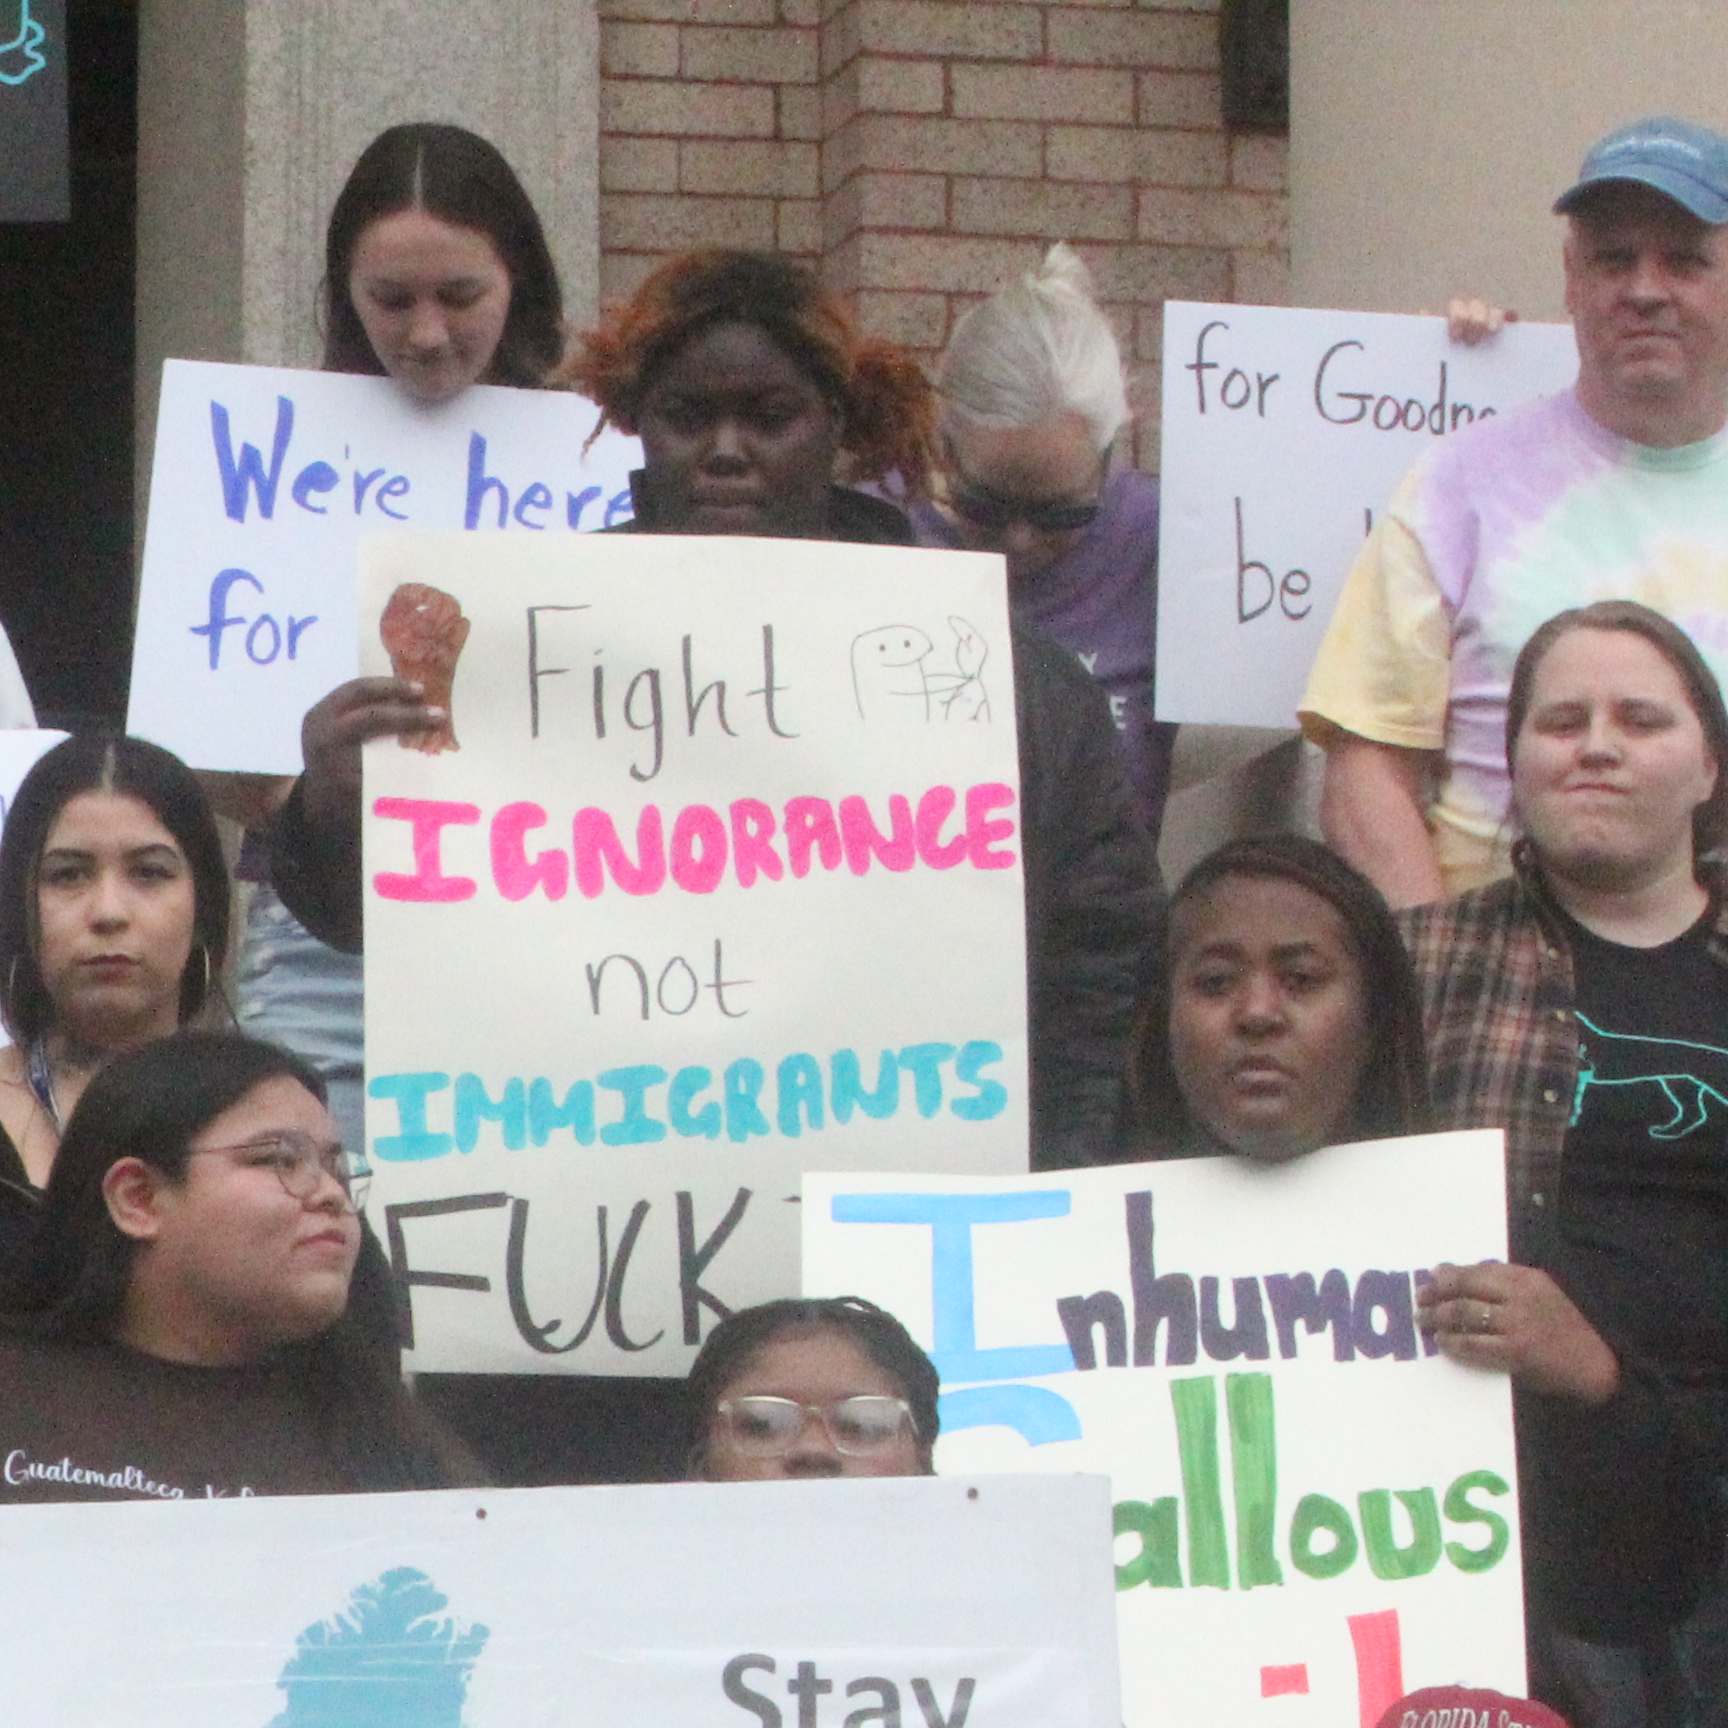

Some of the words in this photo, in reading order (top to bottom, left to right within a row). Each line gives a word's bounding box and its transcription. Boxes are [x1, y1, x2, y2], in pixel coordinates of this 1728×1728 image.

[1185, 321, 1281, 415] for
[210, 395, 411, 523] We're
[190, 567, 320, 672] for
[1234, 496, 1313, 625] be
[526, 604, 802, 783] Fight
[371, 782, 1017, 903] IGNORANCE
[585, 938, 755, 1021] not
[368, 1039, 1009, 1162] IMMIGRANTS
[386, 1187, 753, 1355] FUCK
[939, 1370, 1510, 1592] allous
